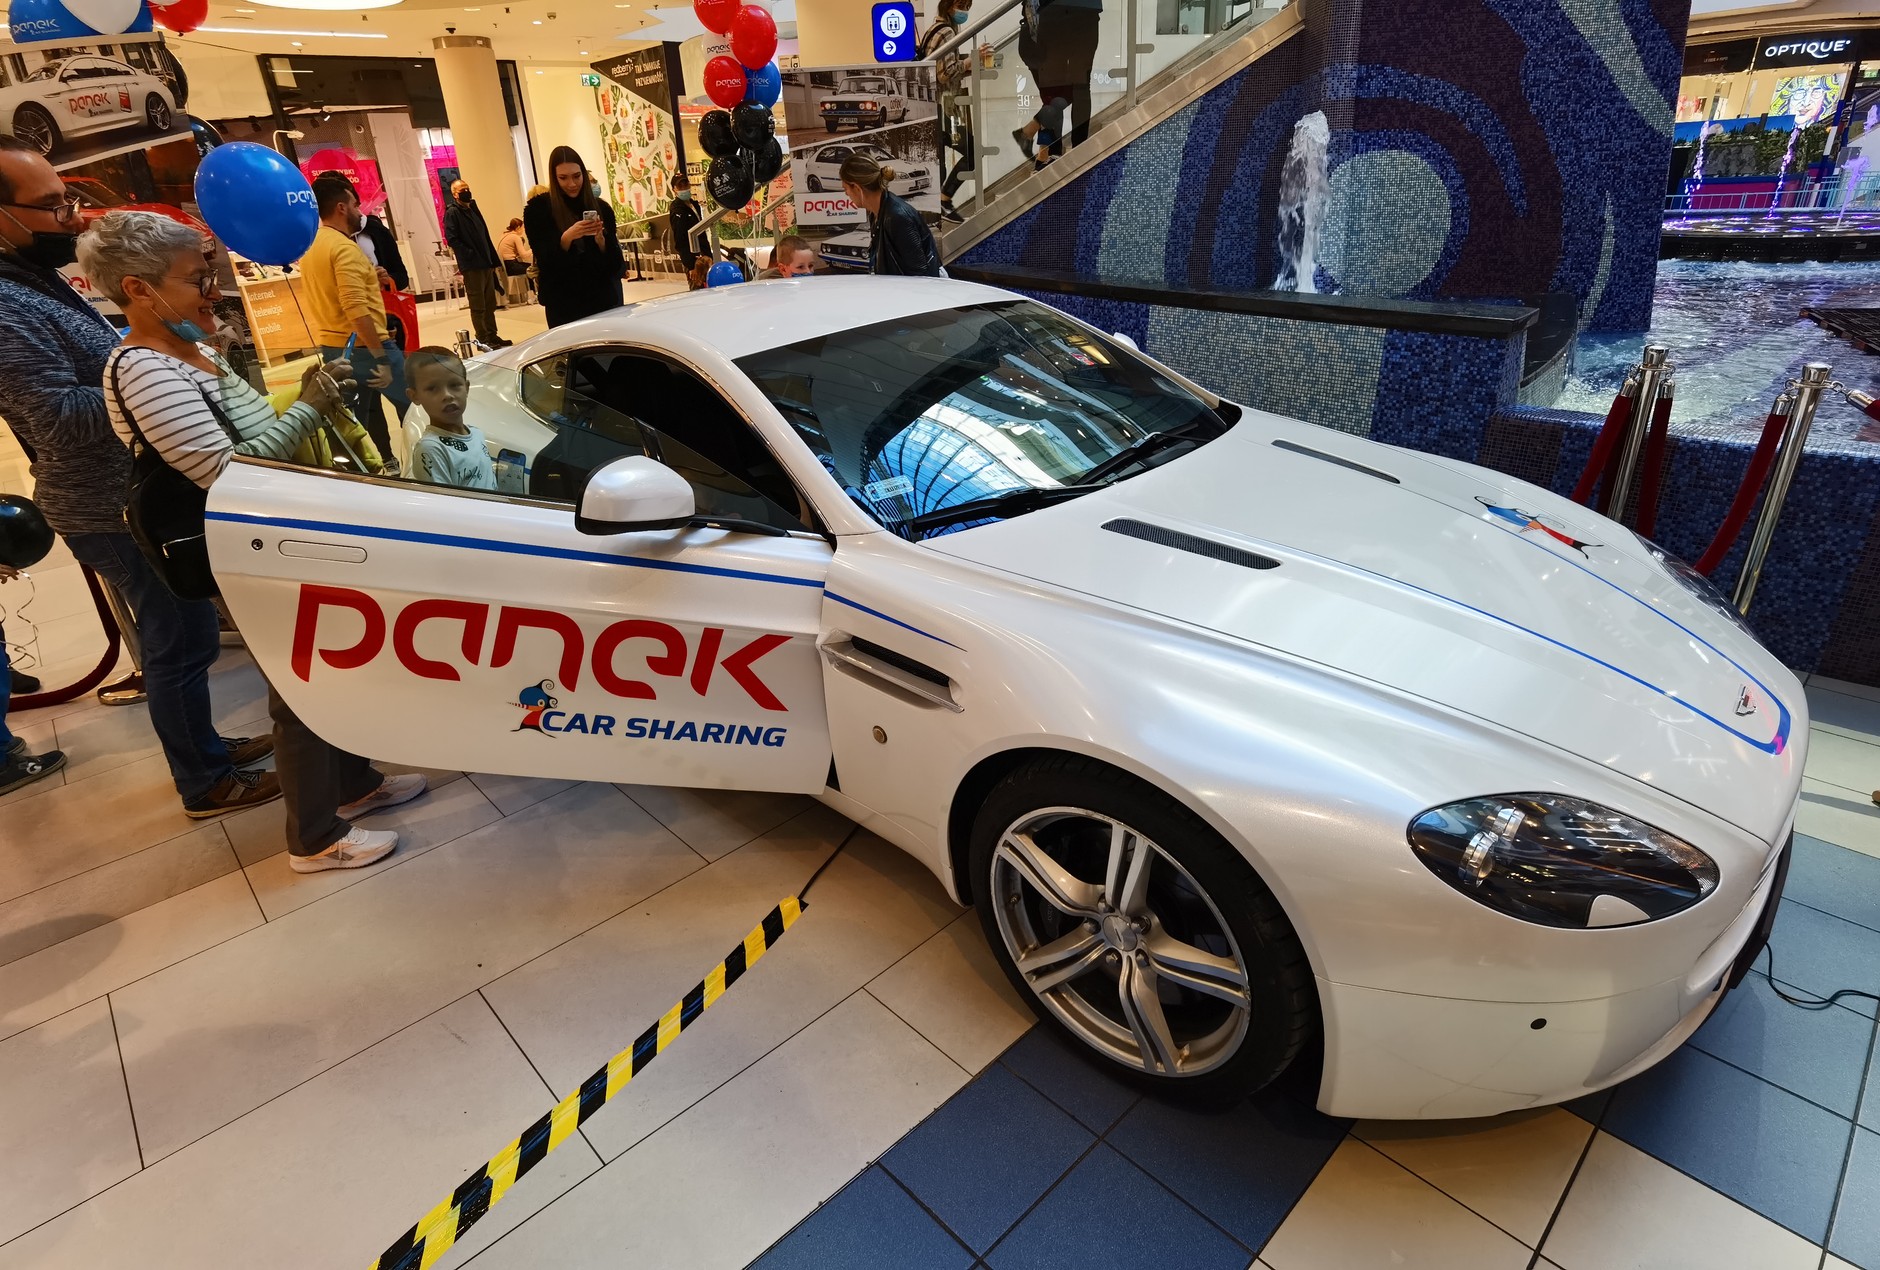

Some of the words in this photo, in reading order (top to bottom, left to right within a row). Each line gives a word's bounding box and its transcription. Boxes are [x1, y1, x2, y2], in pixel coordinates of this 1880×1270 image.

[1765, 40, 1848, 58] OPTIQUE
[69, 92, 111, 114] panek
[804, 199, 858, 214] panek
[291, 583, 794, 712] panek
[542, 711, 616, 736] CAR
[625, 717, 787, 748] SHARING
